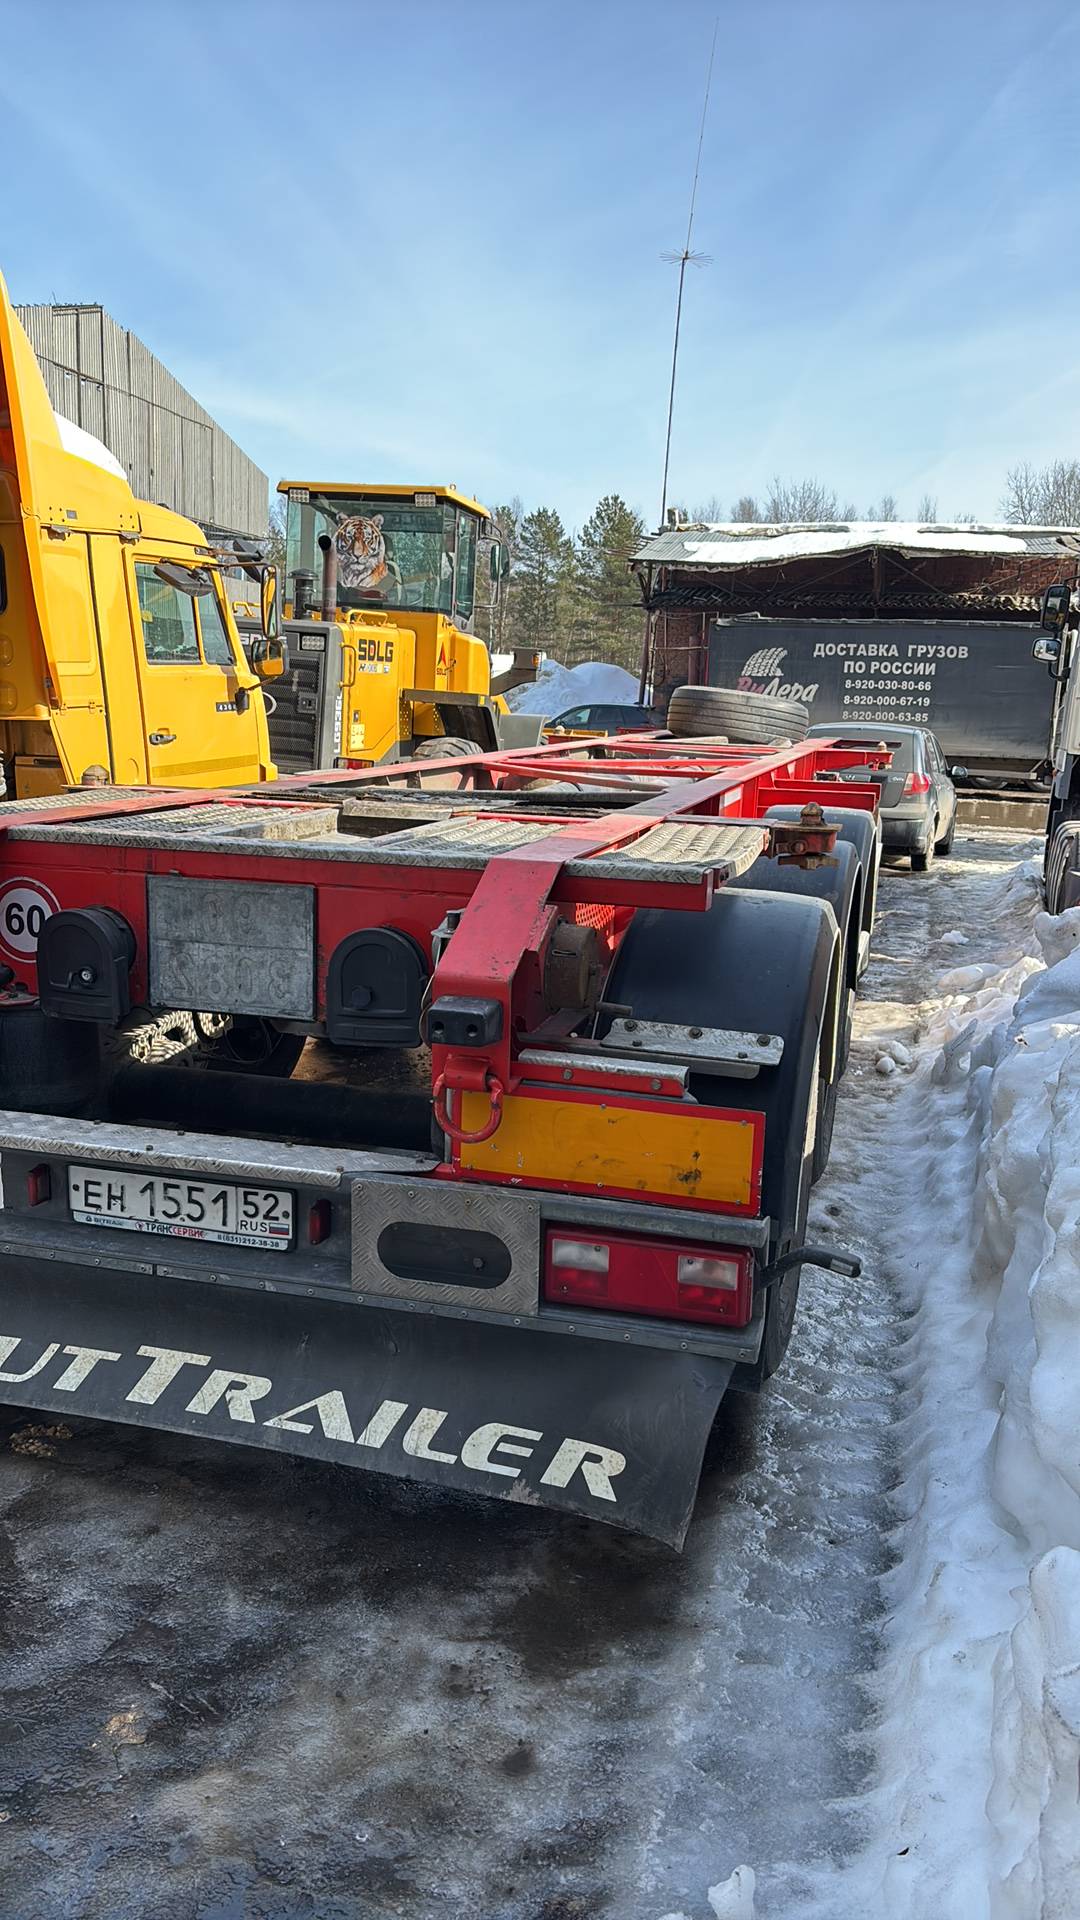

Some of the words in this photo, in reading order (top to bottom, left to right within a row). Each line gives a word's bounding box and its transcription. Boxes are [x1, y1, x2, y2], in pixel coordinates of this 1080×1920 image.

[358, 639, 394, 662] SDLG
[813, 643, 899, 658] ДОСТАВКА
[906, 644, 969, 659] ГРУЗОВ
[843, 661, 868, 674] ПО
[870, 661, 936, 675] РОССИИ
[845, 679, 932, 691] 8-920-030-80-66
[843, 695, 930, 707] 8-920-000-67-19
[842, 710, 929, 723] 8-920-000-63-85
[5, 902, 46, 938] 60
[139, 1181, 229, 1227] 1551
[242, 1190, 280, 1221] 52
[240, 1220, 268, 1233] RUS
